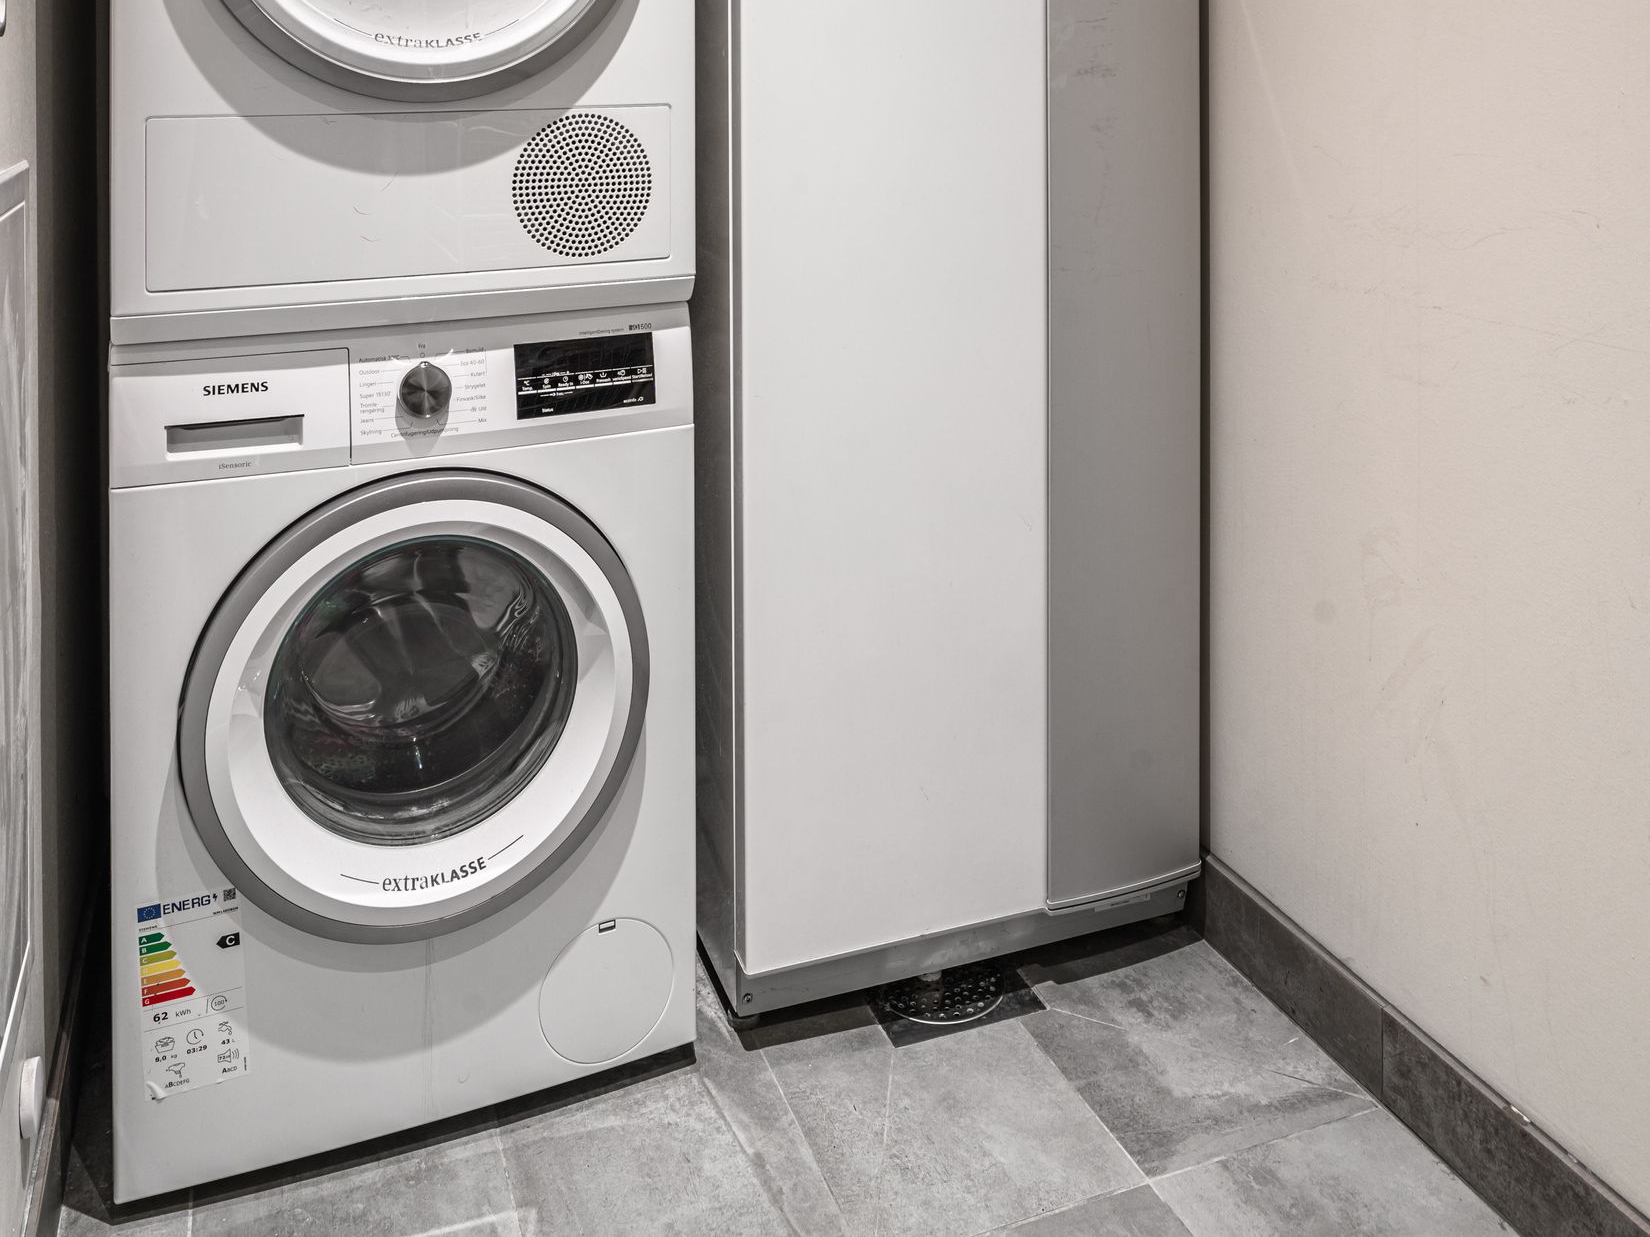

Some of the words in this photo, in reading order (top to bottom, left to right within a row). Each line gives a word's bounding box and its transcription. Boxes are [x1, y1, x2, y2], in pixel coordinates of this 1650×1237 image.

[203, 381, 269, 397] SIEMENS
[382, 856, 487, 892] extraKLASSE
[225, 935, 235, 946] C
[213, 999, 225, 1007] 100
[153, 1011, 169, 1023] 62
[175, 1008, 192, 1018] kWh
[186, 1044, 208, 1055] 03:29
[155, 1054, 167, 1063] 8,0
